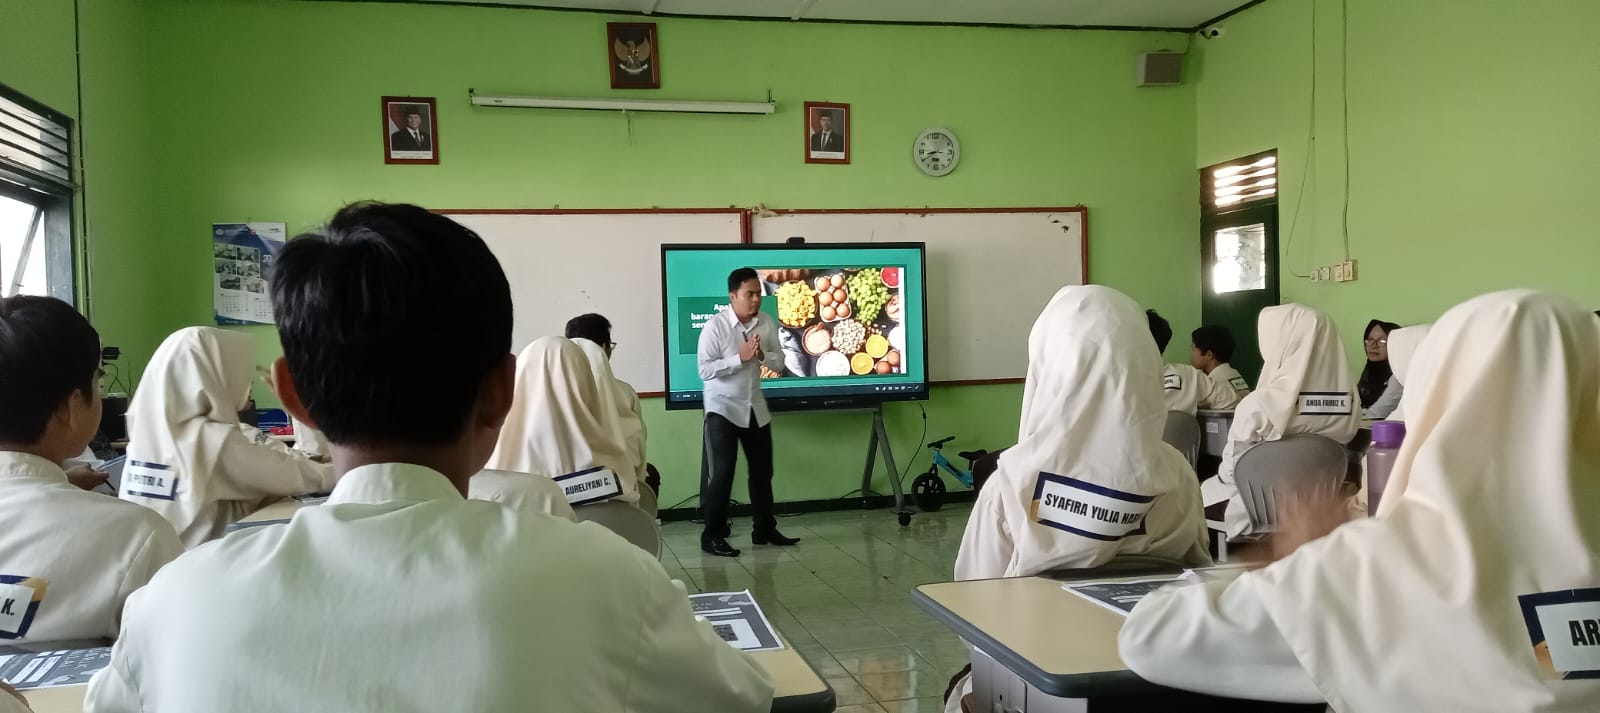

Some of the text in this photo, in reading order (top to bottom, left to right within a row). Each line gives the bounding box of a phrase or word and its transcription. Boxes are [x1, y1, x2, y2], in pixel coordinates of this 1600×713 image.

[690, 312, 716, 321] baran
[1044, 493, 1088, 516] SYAFIRA
[1091, 505, 1120, 523] YULIA
[1, 598, 15, 616] K.
[1568, 619, 1600, 647] AR
